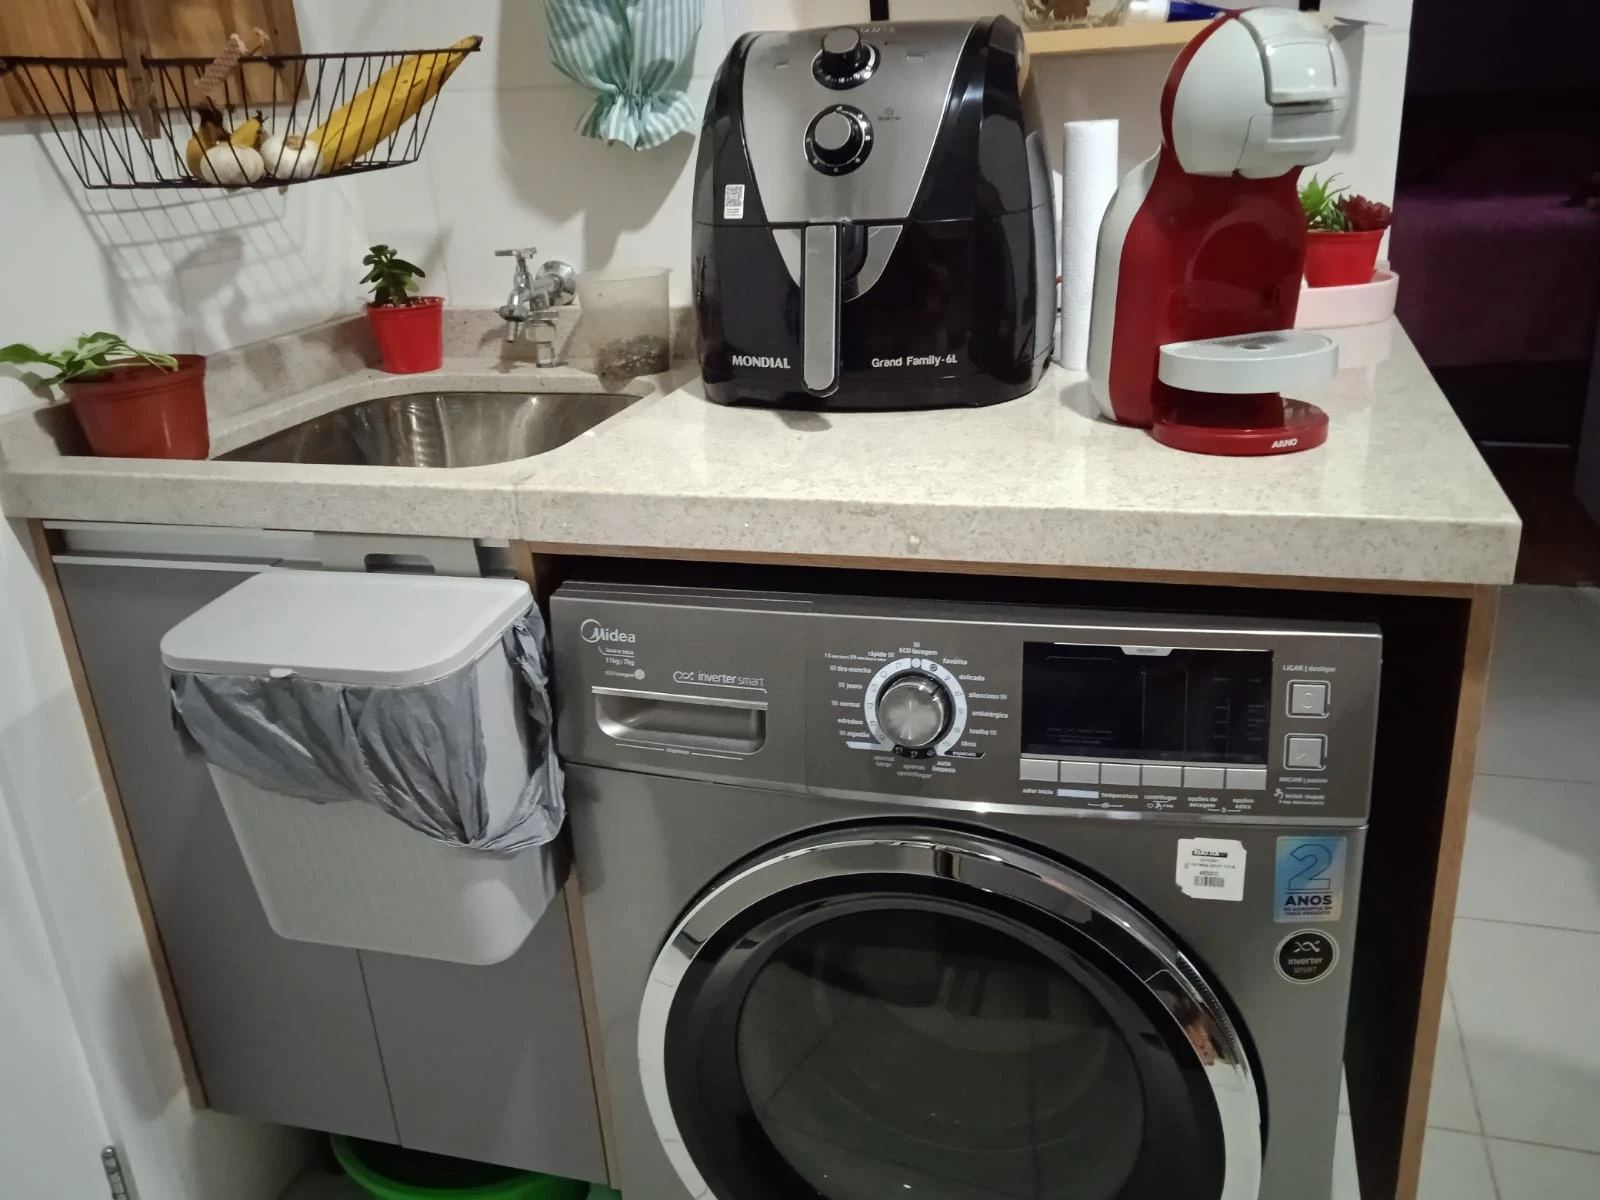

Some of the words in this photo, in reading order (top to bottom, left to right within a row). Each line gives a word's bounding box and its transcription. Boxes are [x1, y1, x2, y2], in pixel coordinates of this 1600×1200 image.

[732, 355, 790, 369] MONDIAL
[872, 358, 902, 368] Grand
[581, 619, 636, 643] Midea
[698, 670, 736, 684] inverter
[737, 676, 765, 687] smart
[1288, 843, 1333, 891] 2
[1284, 895, 1333, 906] ANOS
